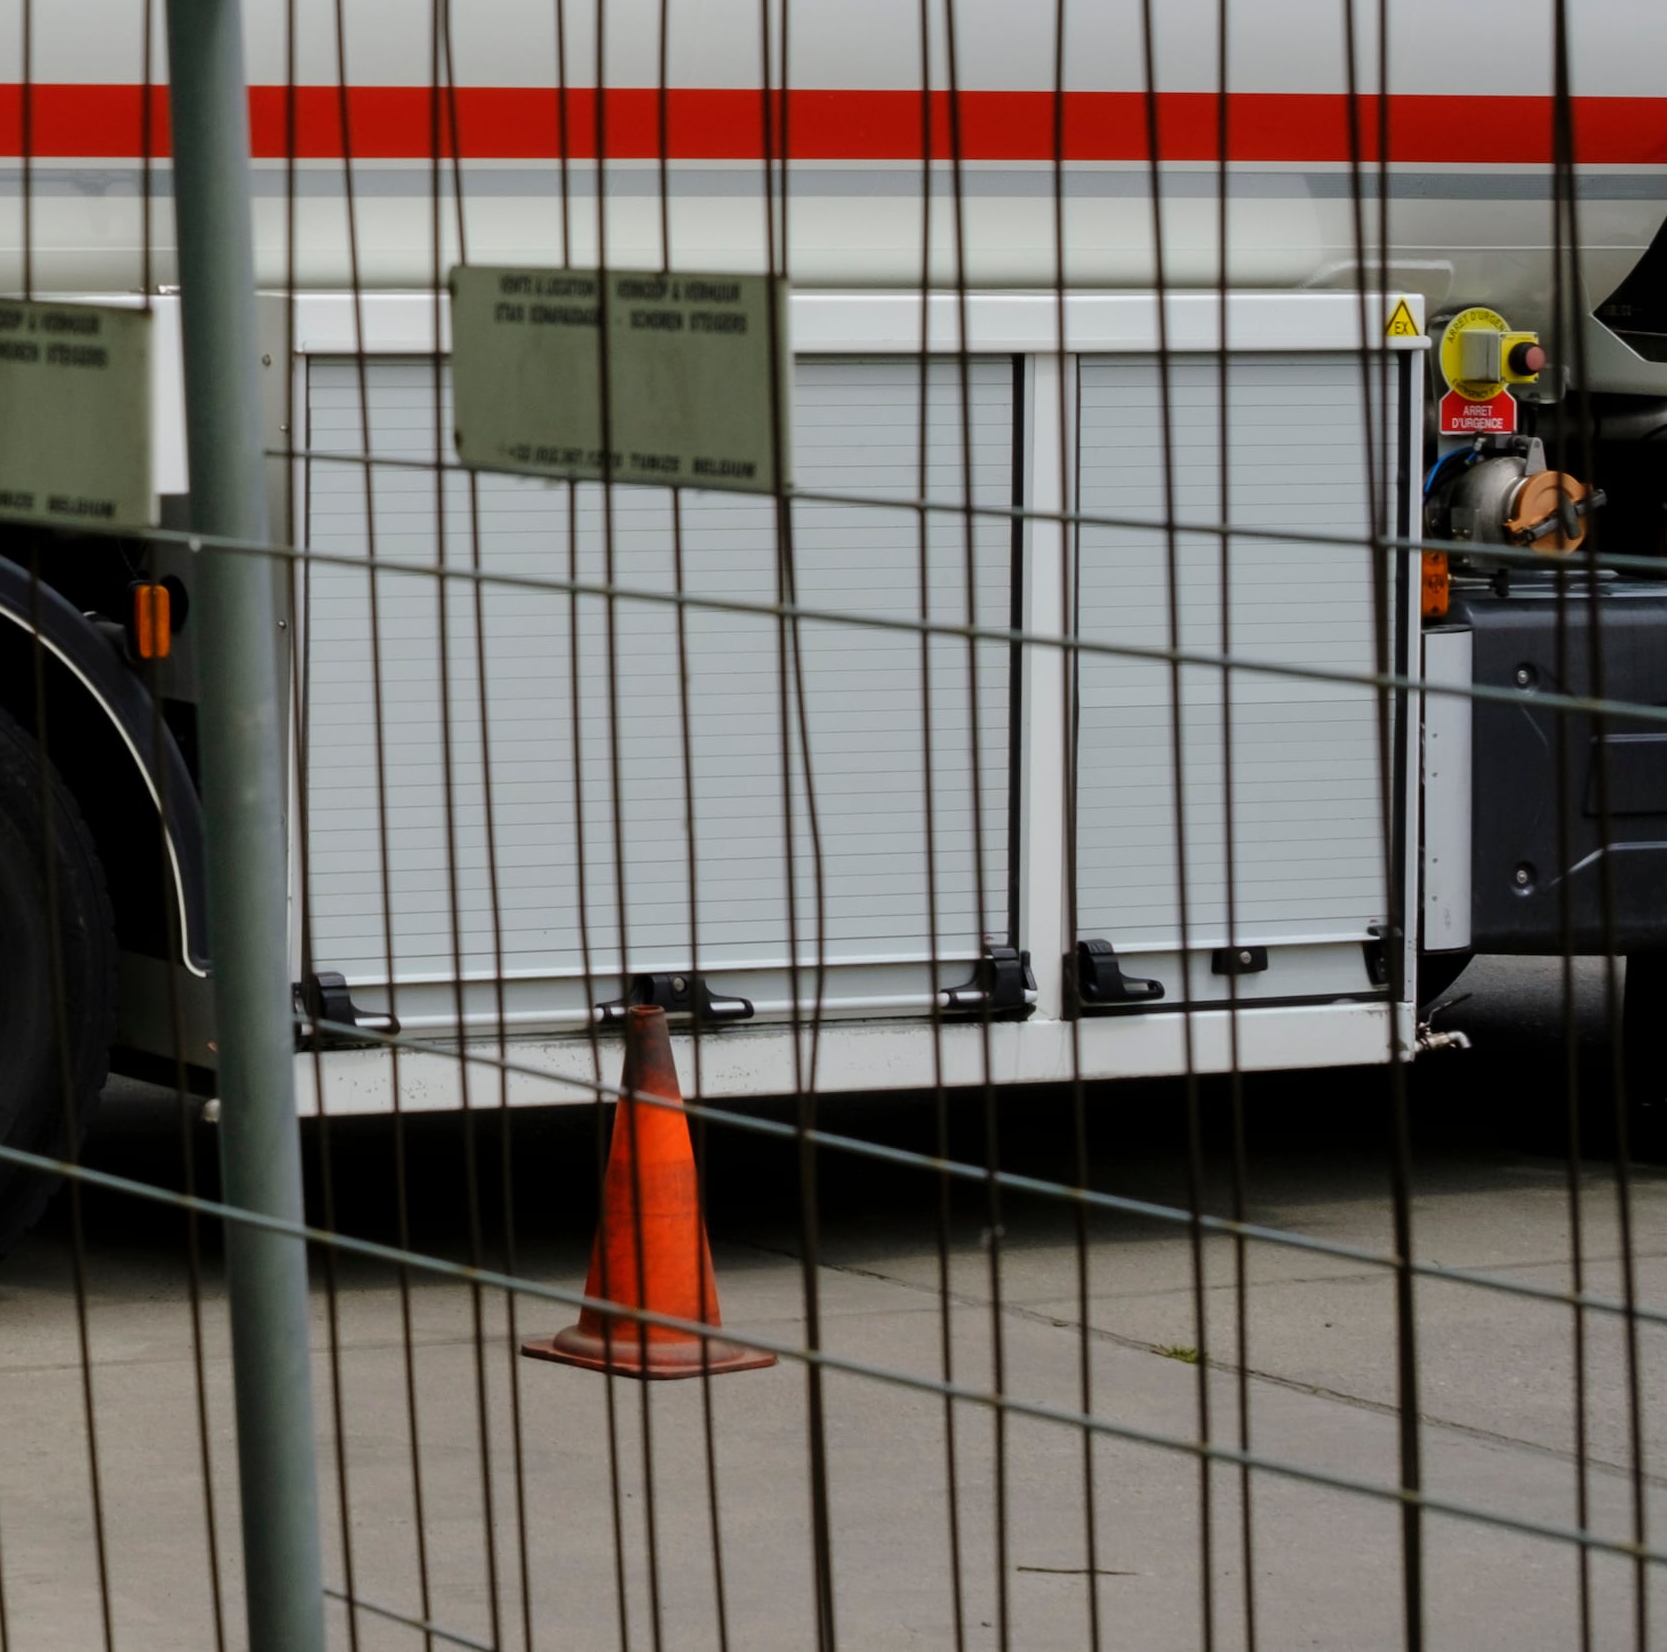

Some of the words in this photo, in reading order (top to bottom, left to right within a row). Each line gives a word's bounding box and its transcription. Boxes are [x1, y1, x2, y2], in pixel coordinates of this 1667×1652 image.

[1394, 320, 1409, 335] EX
[1462, 405, 1494, 417] ARRET
[1451, 417, 1505, 430] D'URGENCE
